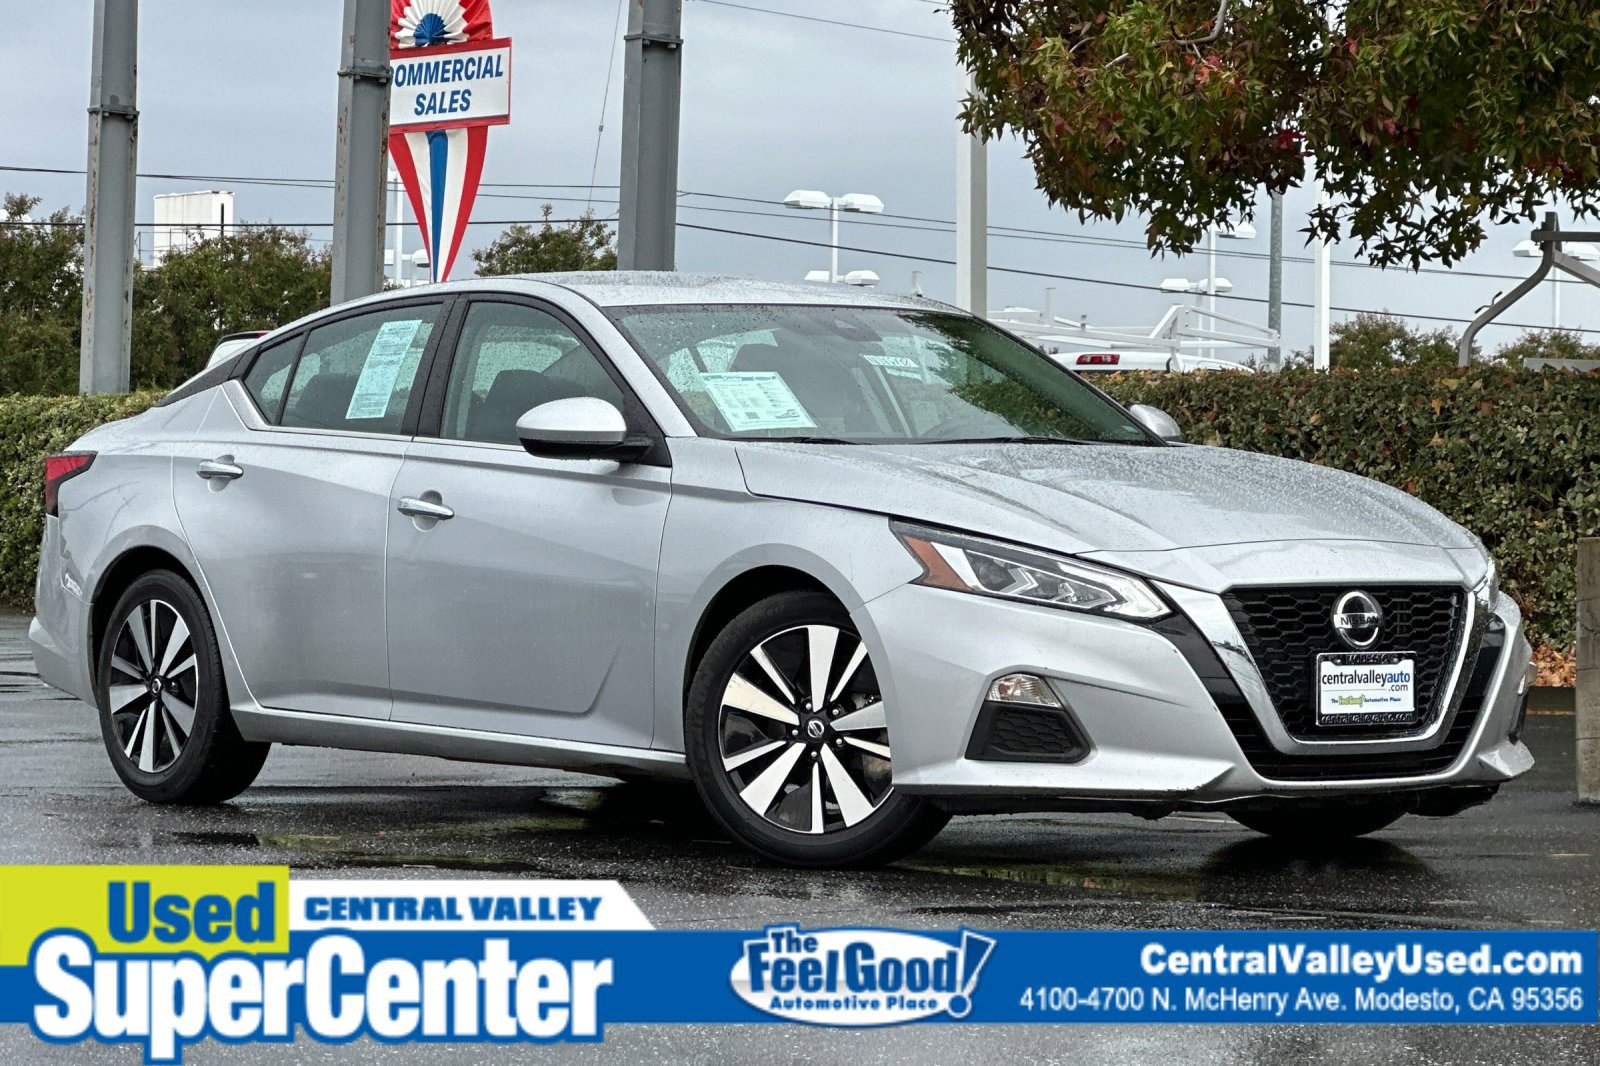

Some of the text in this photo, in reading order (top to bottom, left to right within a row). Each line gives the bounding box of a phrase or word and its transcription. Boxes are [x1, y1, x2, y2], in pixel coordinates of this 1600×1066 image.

[414, 89, 472, 116] SALES
[1322, 669, 1411, 687] centralvalleyauto
[1388, 684, 1408, 692] .com
